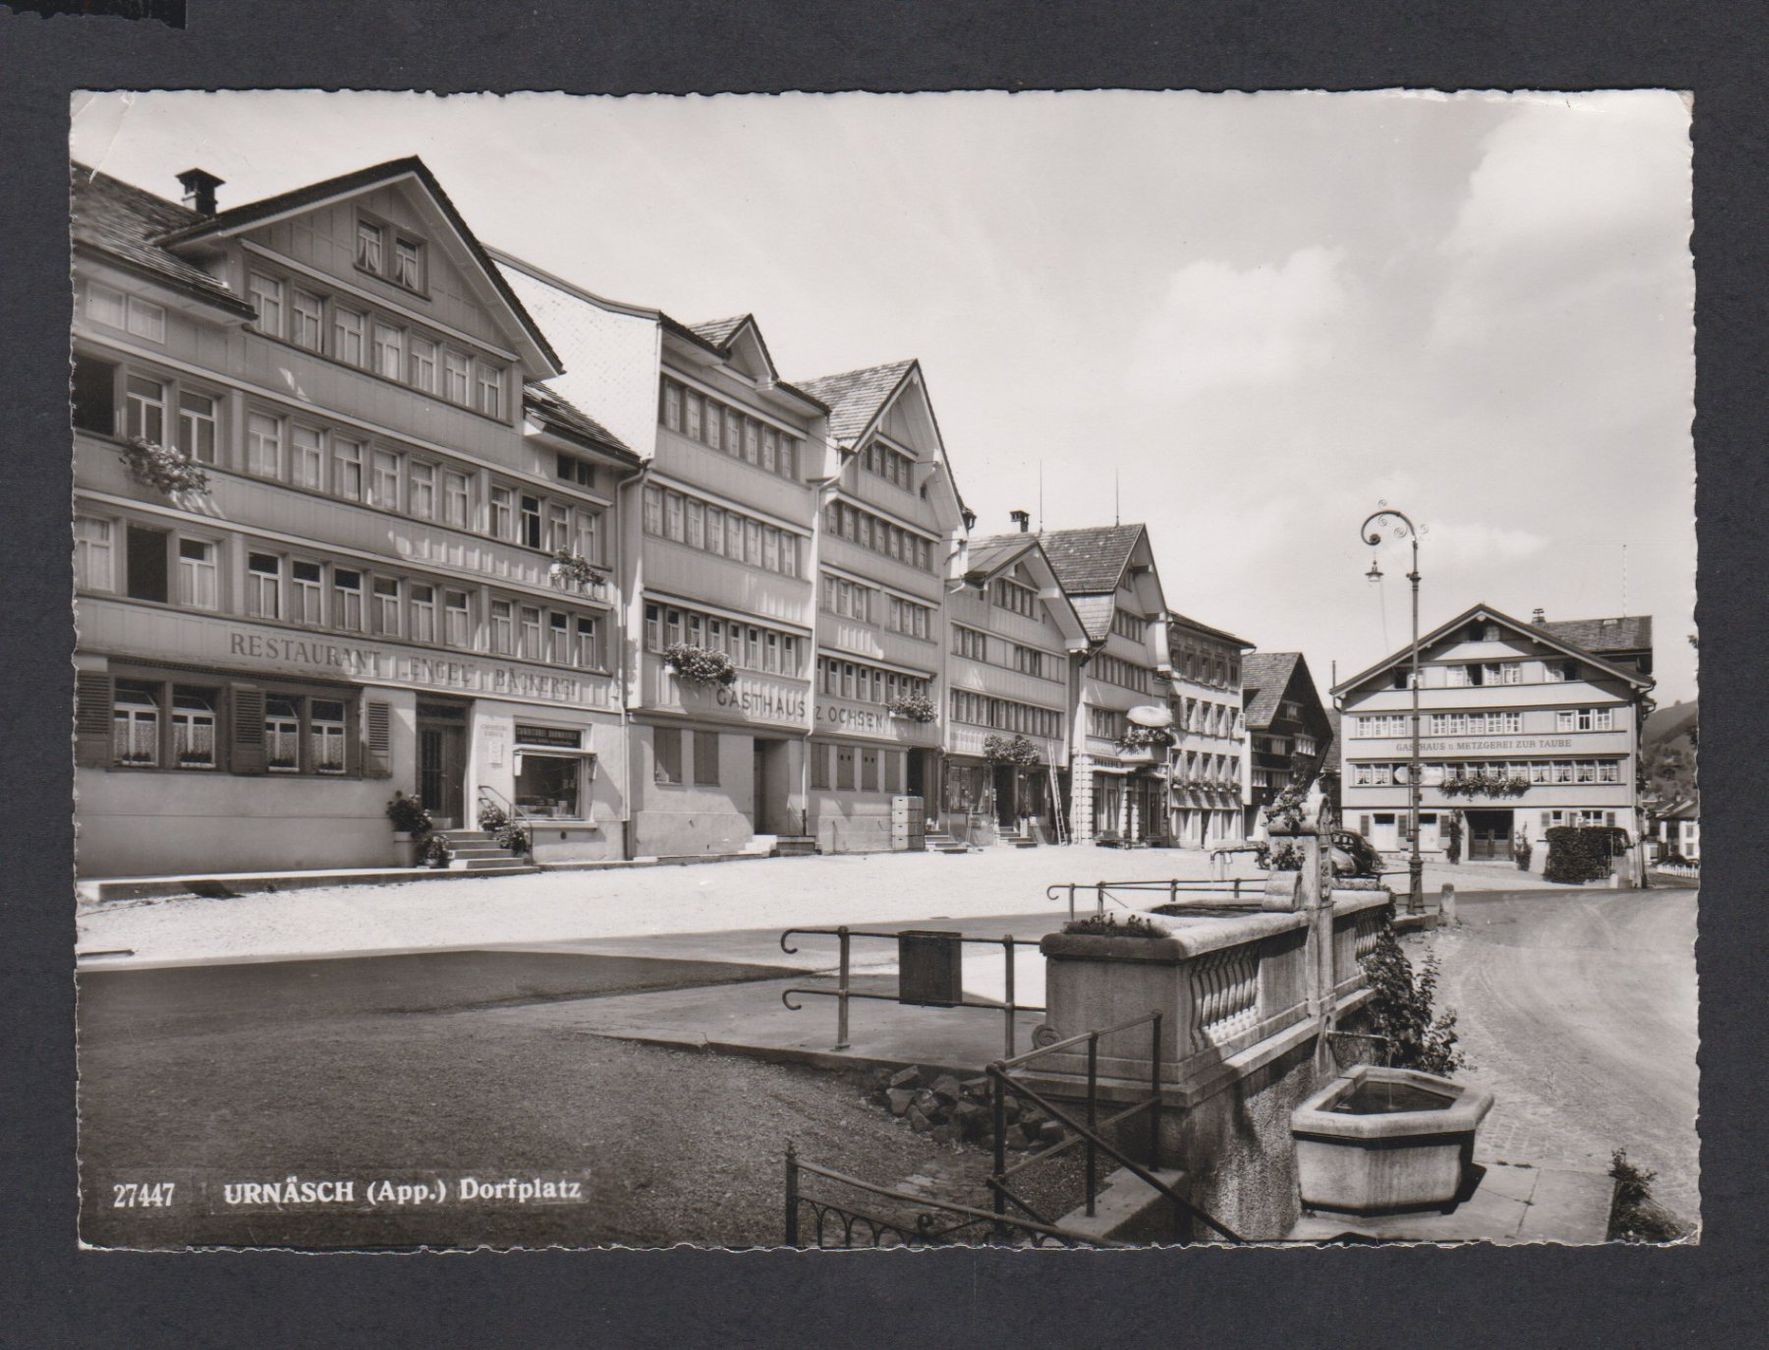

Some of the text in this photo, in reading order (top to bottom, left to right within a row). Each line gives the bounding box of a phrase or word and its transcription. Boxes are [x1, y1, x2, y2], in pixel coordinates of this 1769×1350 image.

[230, 632, 381, 677] RESTAURANT
[716, 688, 805, 718] GASTHAUS
[828, 706, 883, 729] OCHSEN
[1396, 742, 1446, 752] GASHAUS
[1457, 741, 1513, 751] METZGEREI
[1516, 740, 1536, 750] ZUR
[1540, 738, 1573, 749] TAUBE
